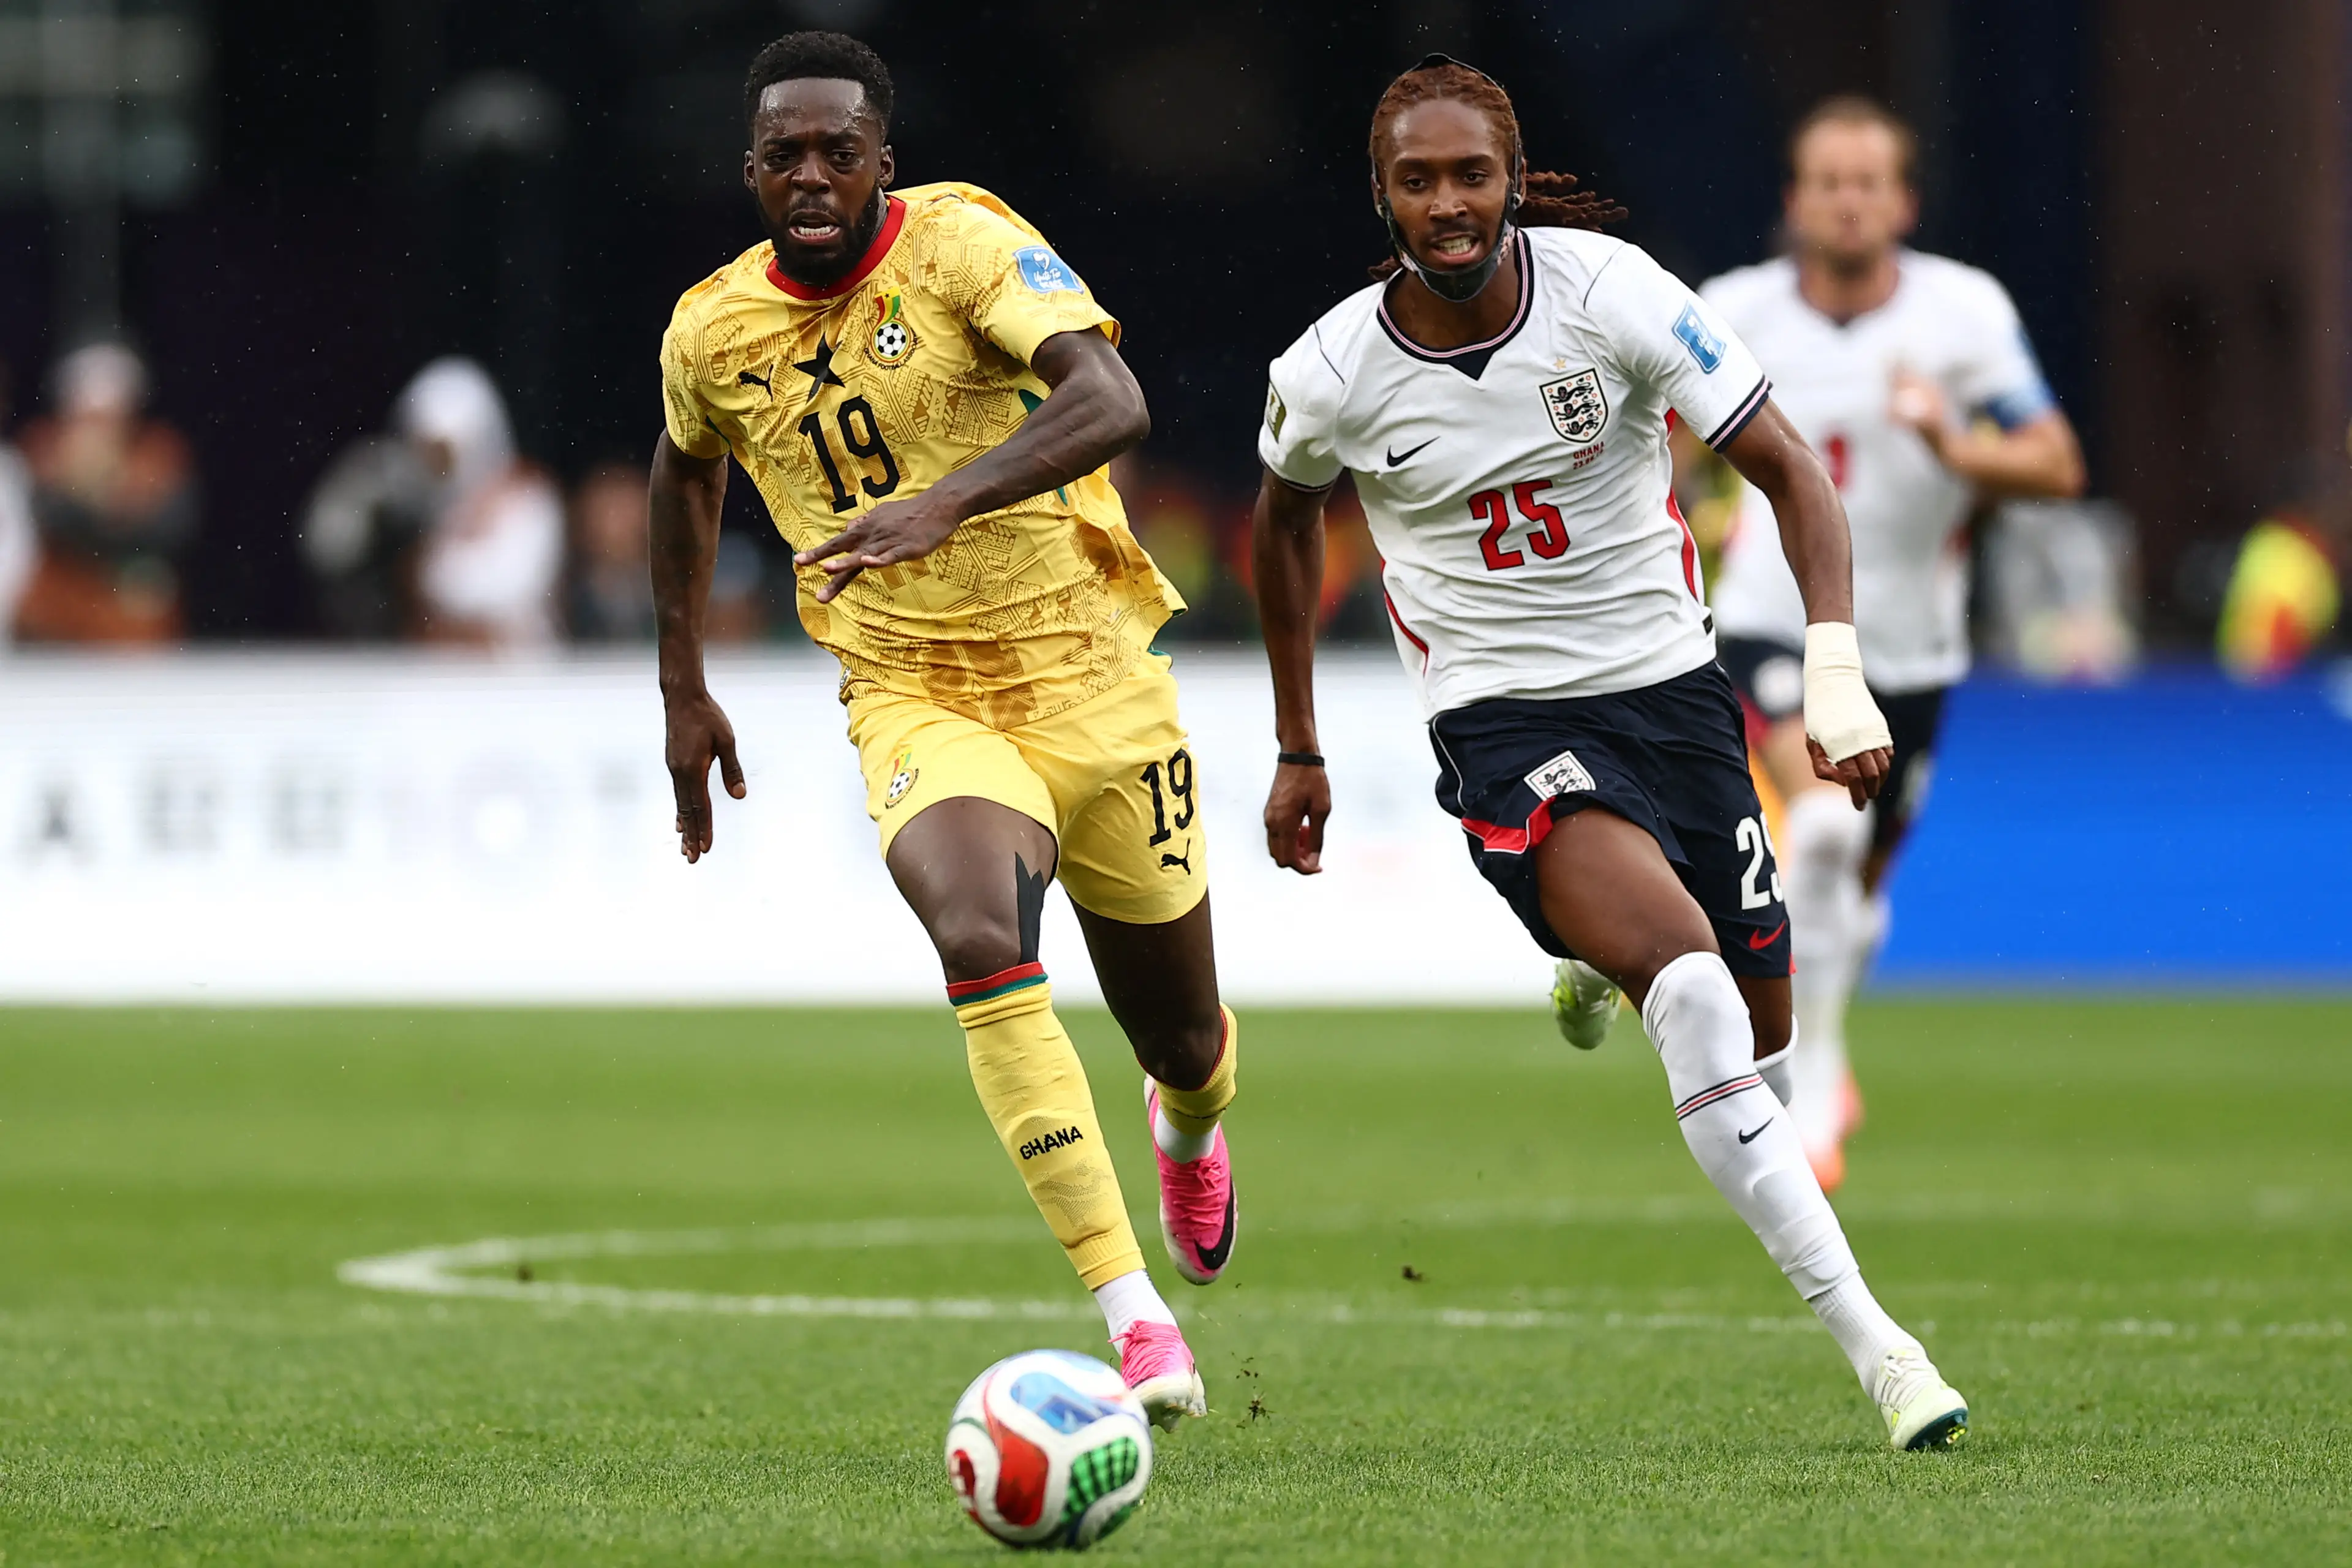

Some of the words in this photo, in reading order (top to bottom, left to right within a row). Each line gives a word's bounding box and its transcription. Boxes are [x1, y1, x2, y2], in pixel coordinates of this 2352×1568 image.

[878, 361, 905, 371] FOOTBALL
[797, 394, 900, 513] 19
[1467, 480, 1570, 570] 25
[1139, 748, 1194, 847] 19
[1019, 1126, 1084, 1160] GHANA
